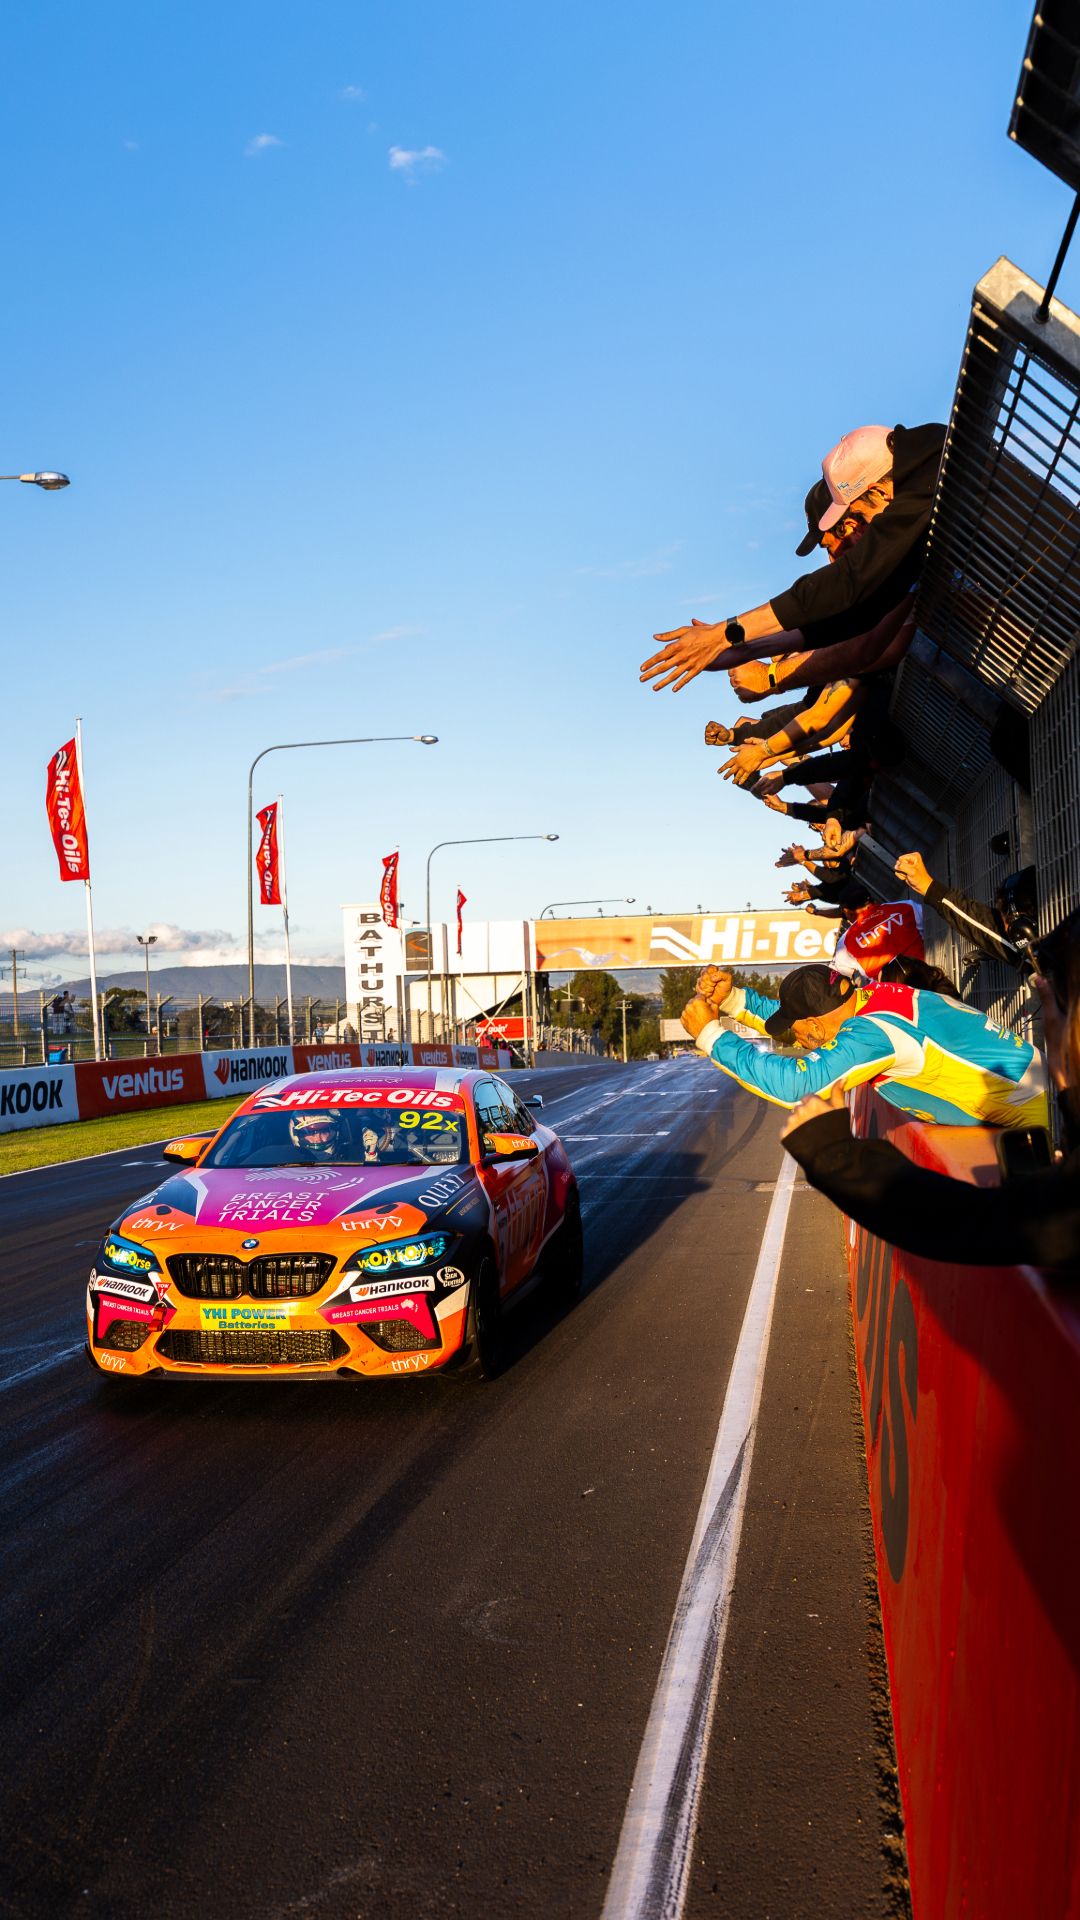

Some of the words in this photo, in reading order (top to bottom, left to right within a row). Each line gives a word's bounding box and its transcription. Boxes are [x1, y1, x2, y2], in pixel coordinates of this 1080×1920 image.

[55, 770, 71, 831] Hi-Tec
[61, 834, 81, 873] Oils
[855, 912, 903, 948] thryv
[358, 913, 384, 1044] BATHURST
[284, 1089, 382, 1106] Hi-Tec
[386, 1089, 454, 1107] Oils
[230, 1191, 330, 1201] BREAST
[222, 1200, 323, 1211] CANCER
[218, 1209, 315, 1222] TRIALS
[131, 1217, 185, 1232] thryv
[341, 1216, 402, 1231] thryv
[202, 1308, 227, 1319] YHI
[230, 1308, 287, 1320] POWER
[331, 1310, 354, 1319] BREAST
[354, 1307, 377, 1317] CANCER
[377, 1304, 399, 1314] TRIALS
[218, 1320, 276, 1329] Batteries
[100, 1351, 127, 1371] thryv
[391, 1353, 428, 1372] thryv
